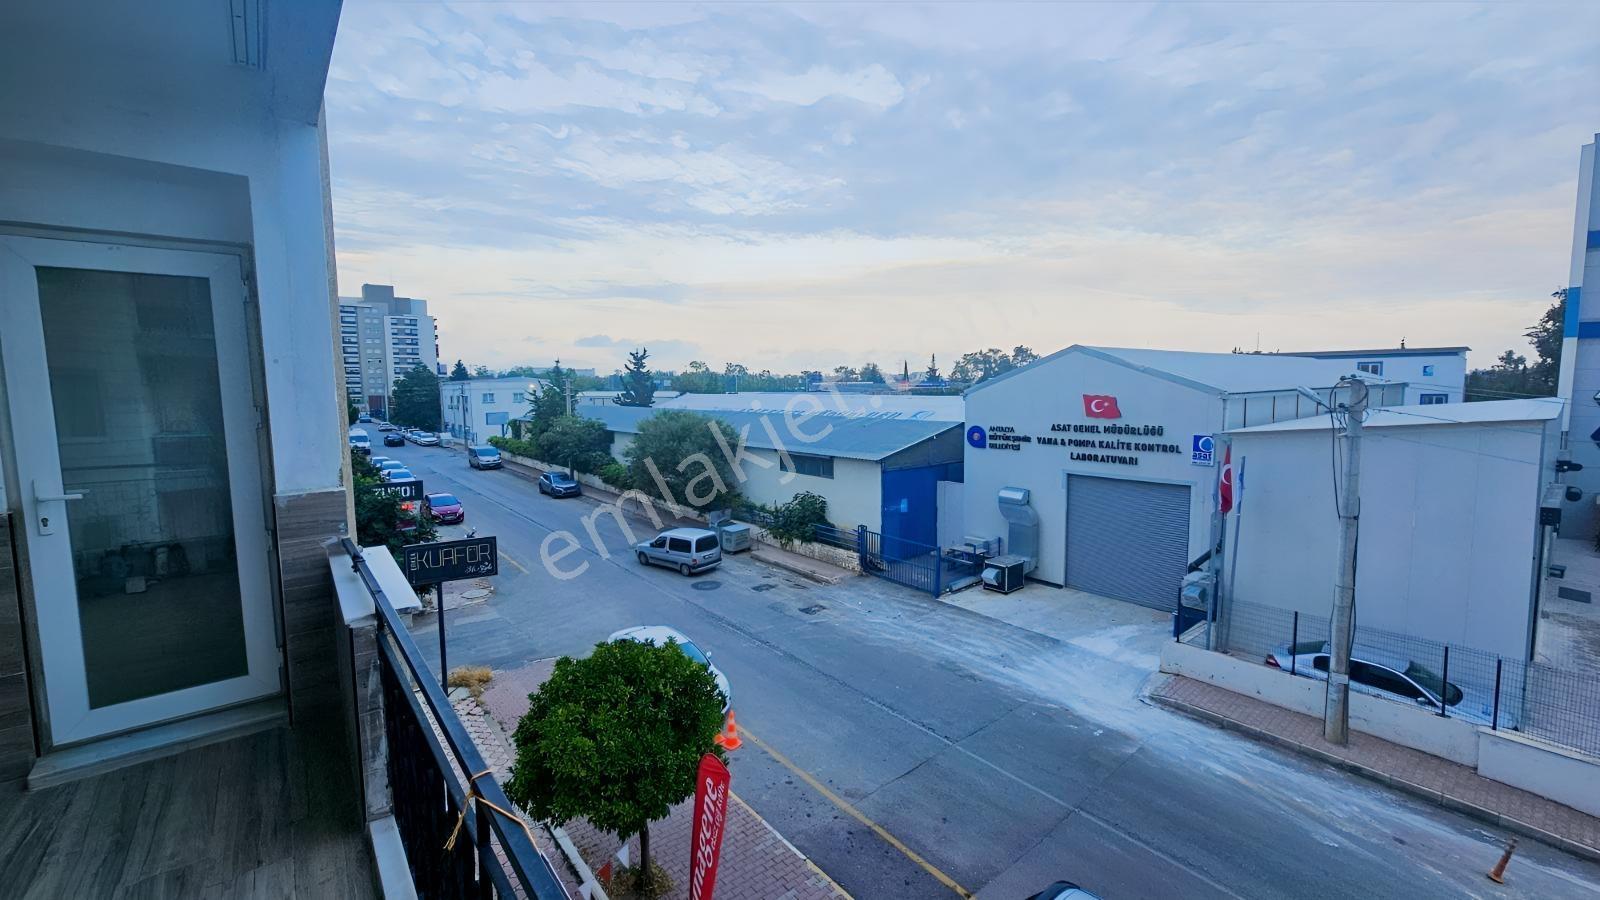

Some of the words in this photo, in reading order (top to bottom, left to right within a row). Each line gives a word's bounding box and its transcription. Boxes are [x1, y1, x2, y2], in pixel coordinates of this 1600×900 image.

[1050, 423, 1071, 433] ASAT
[1072, 424, 1101, 435] GENEL
[1103, 423, 1164, 436] MÜDÜRLÜĞÜ
[1036, 437, 1058, 447] VANA
[1060, 438, 1066, 447] &
[1067, 438, 1097, 449] POMPA
[1098, 439, 1133, 452] KALİTE
[1134, 442, 1182, 454] KONTROL
[1070, 452, 1139, 466] LABORATUVARI
